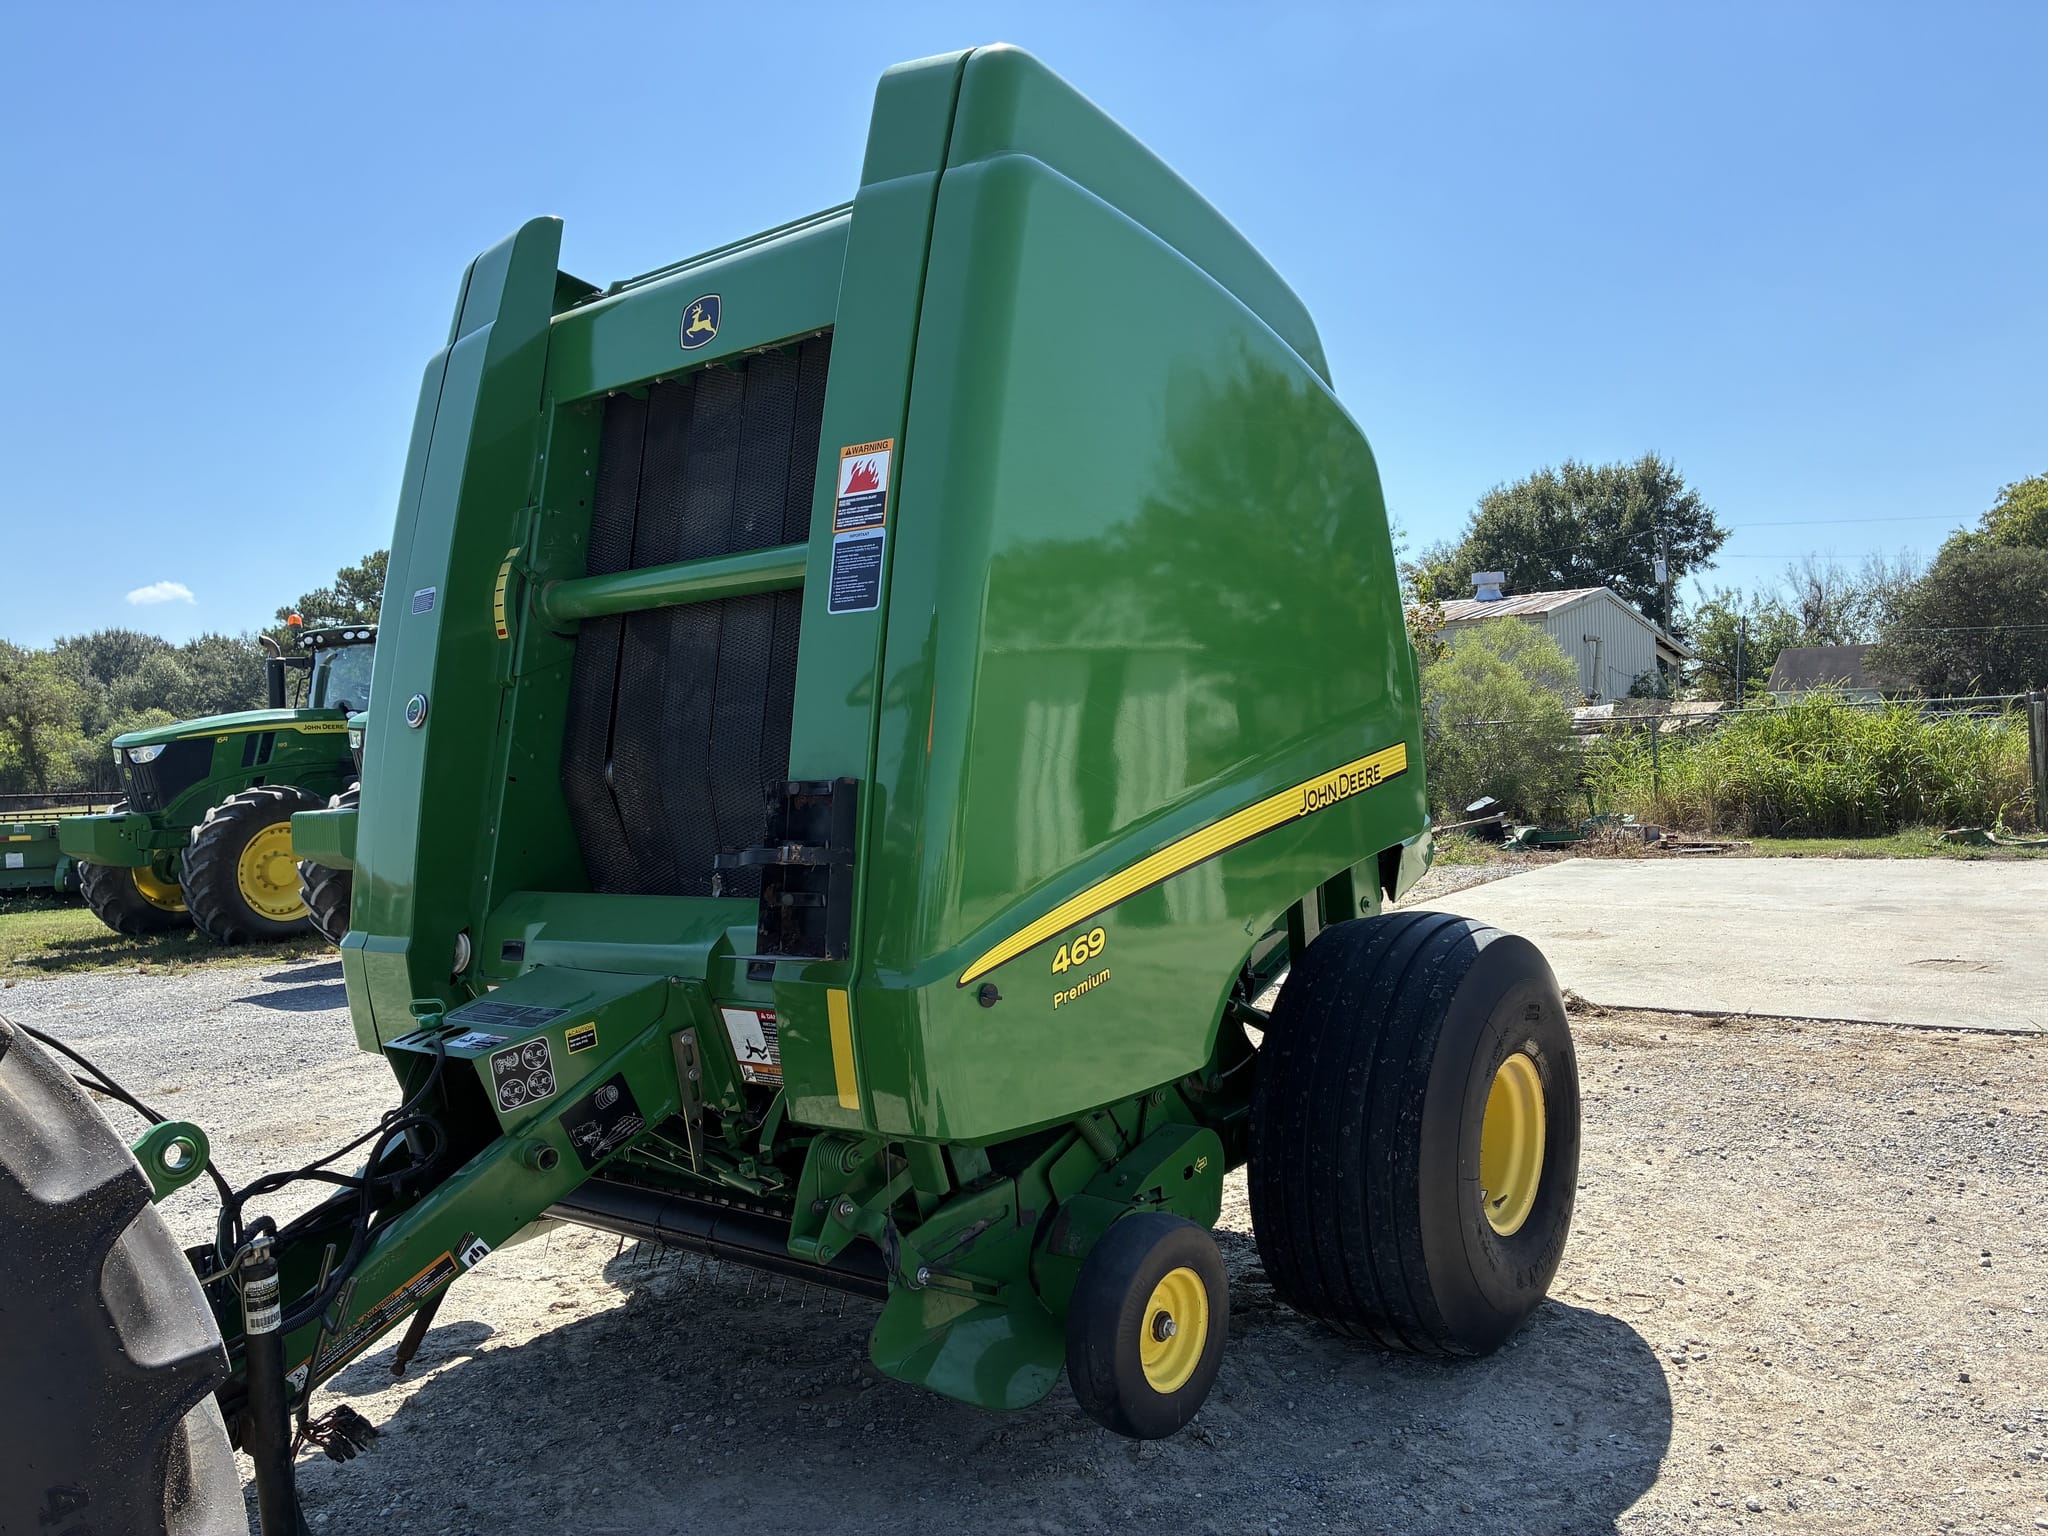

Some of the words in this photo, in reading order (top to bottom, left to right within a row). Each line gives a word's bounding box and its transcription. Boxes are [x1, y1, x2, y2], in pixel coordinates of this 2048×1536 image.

[852, 441, 888, 453] WARNING
[303, 723, 321, 731] JOHN
[1299, 782, 1337, 813] JOHN
[1338, 763, 1381, 796] DEERE
[1051, 926, 1106, 975] 469
[1053, 968, 1110, 1010] Premium
